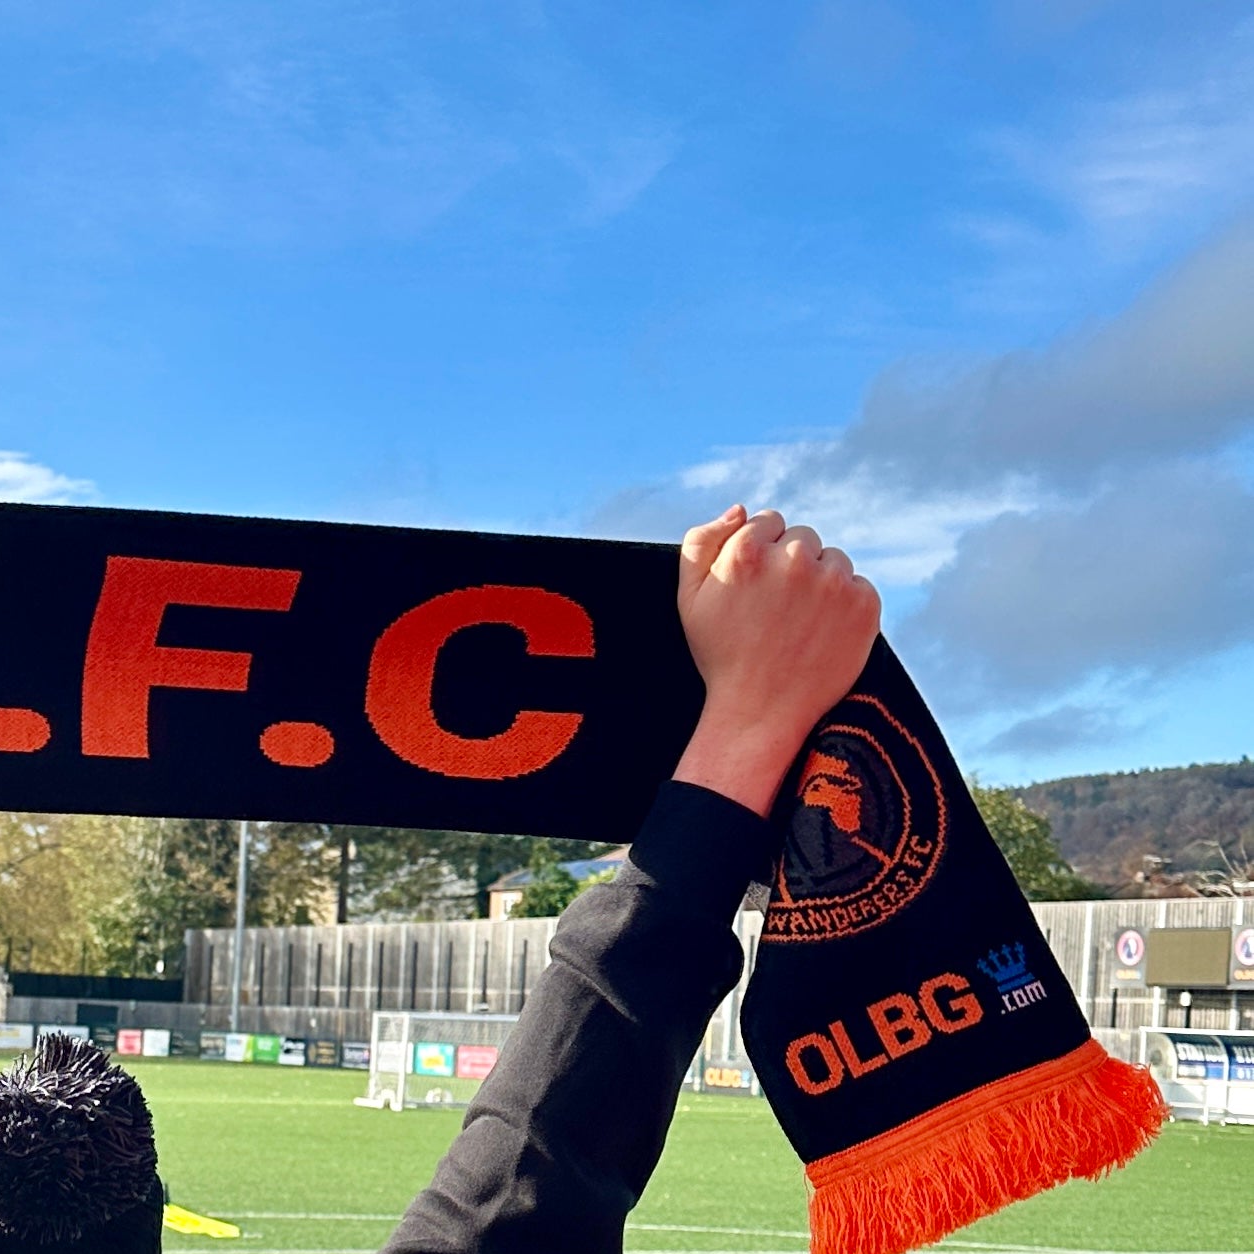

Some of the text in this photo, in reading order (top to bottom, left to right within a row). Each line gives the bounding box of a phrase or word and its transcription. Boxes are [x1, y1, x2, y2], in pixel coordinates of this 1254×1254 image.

[767, 835, 933, 933] WANDERERS FC
[784, 971, 1048, 1096] OLBG .com
